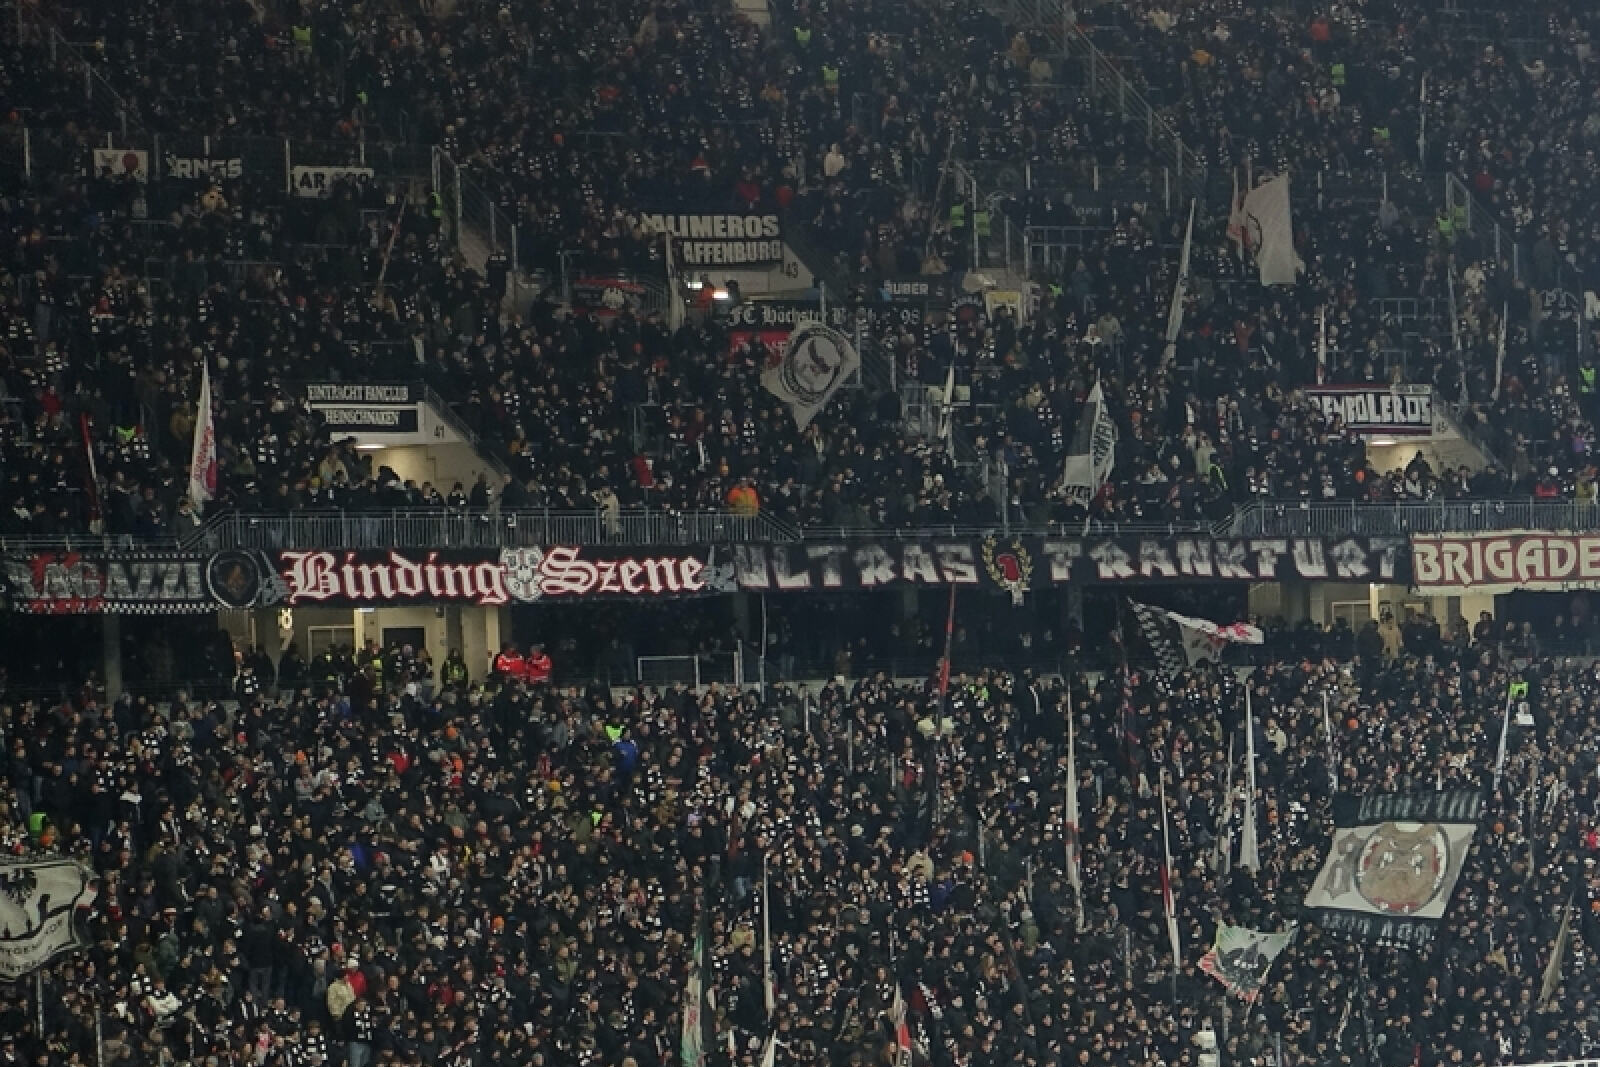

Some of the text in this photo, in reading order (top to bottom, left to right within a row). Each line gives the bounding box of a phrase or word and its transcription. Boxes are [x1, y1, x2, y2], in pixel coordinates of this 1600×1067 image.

[325, 408, 399, 425] HEINSCHNAKEN
[280, 545, 704, 605] Binding Szene
[734, 538, 1396, 589] ULTRAS FRANKFURT
